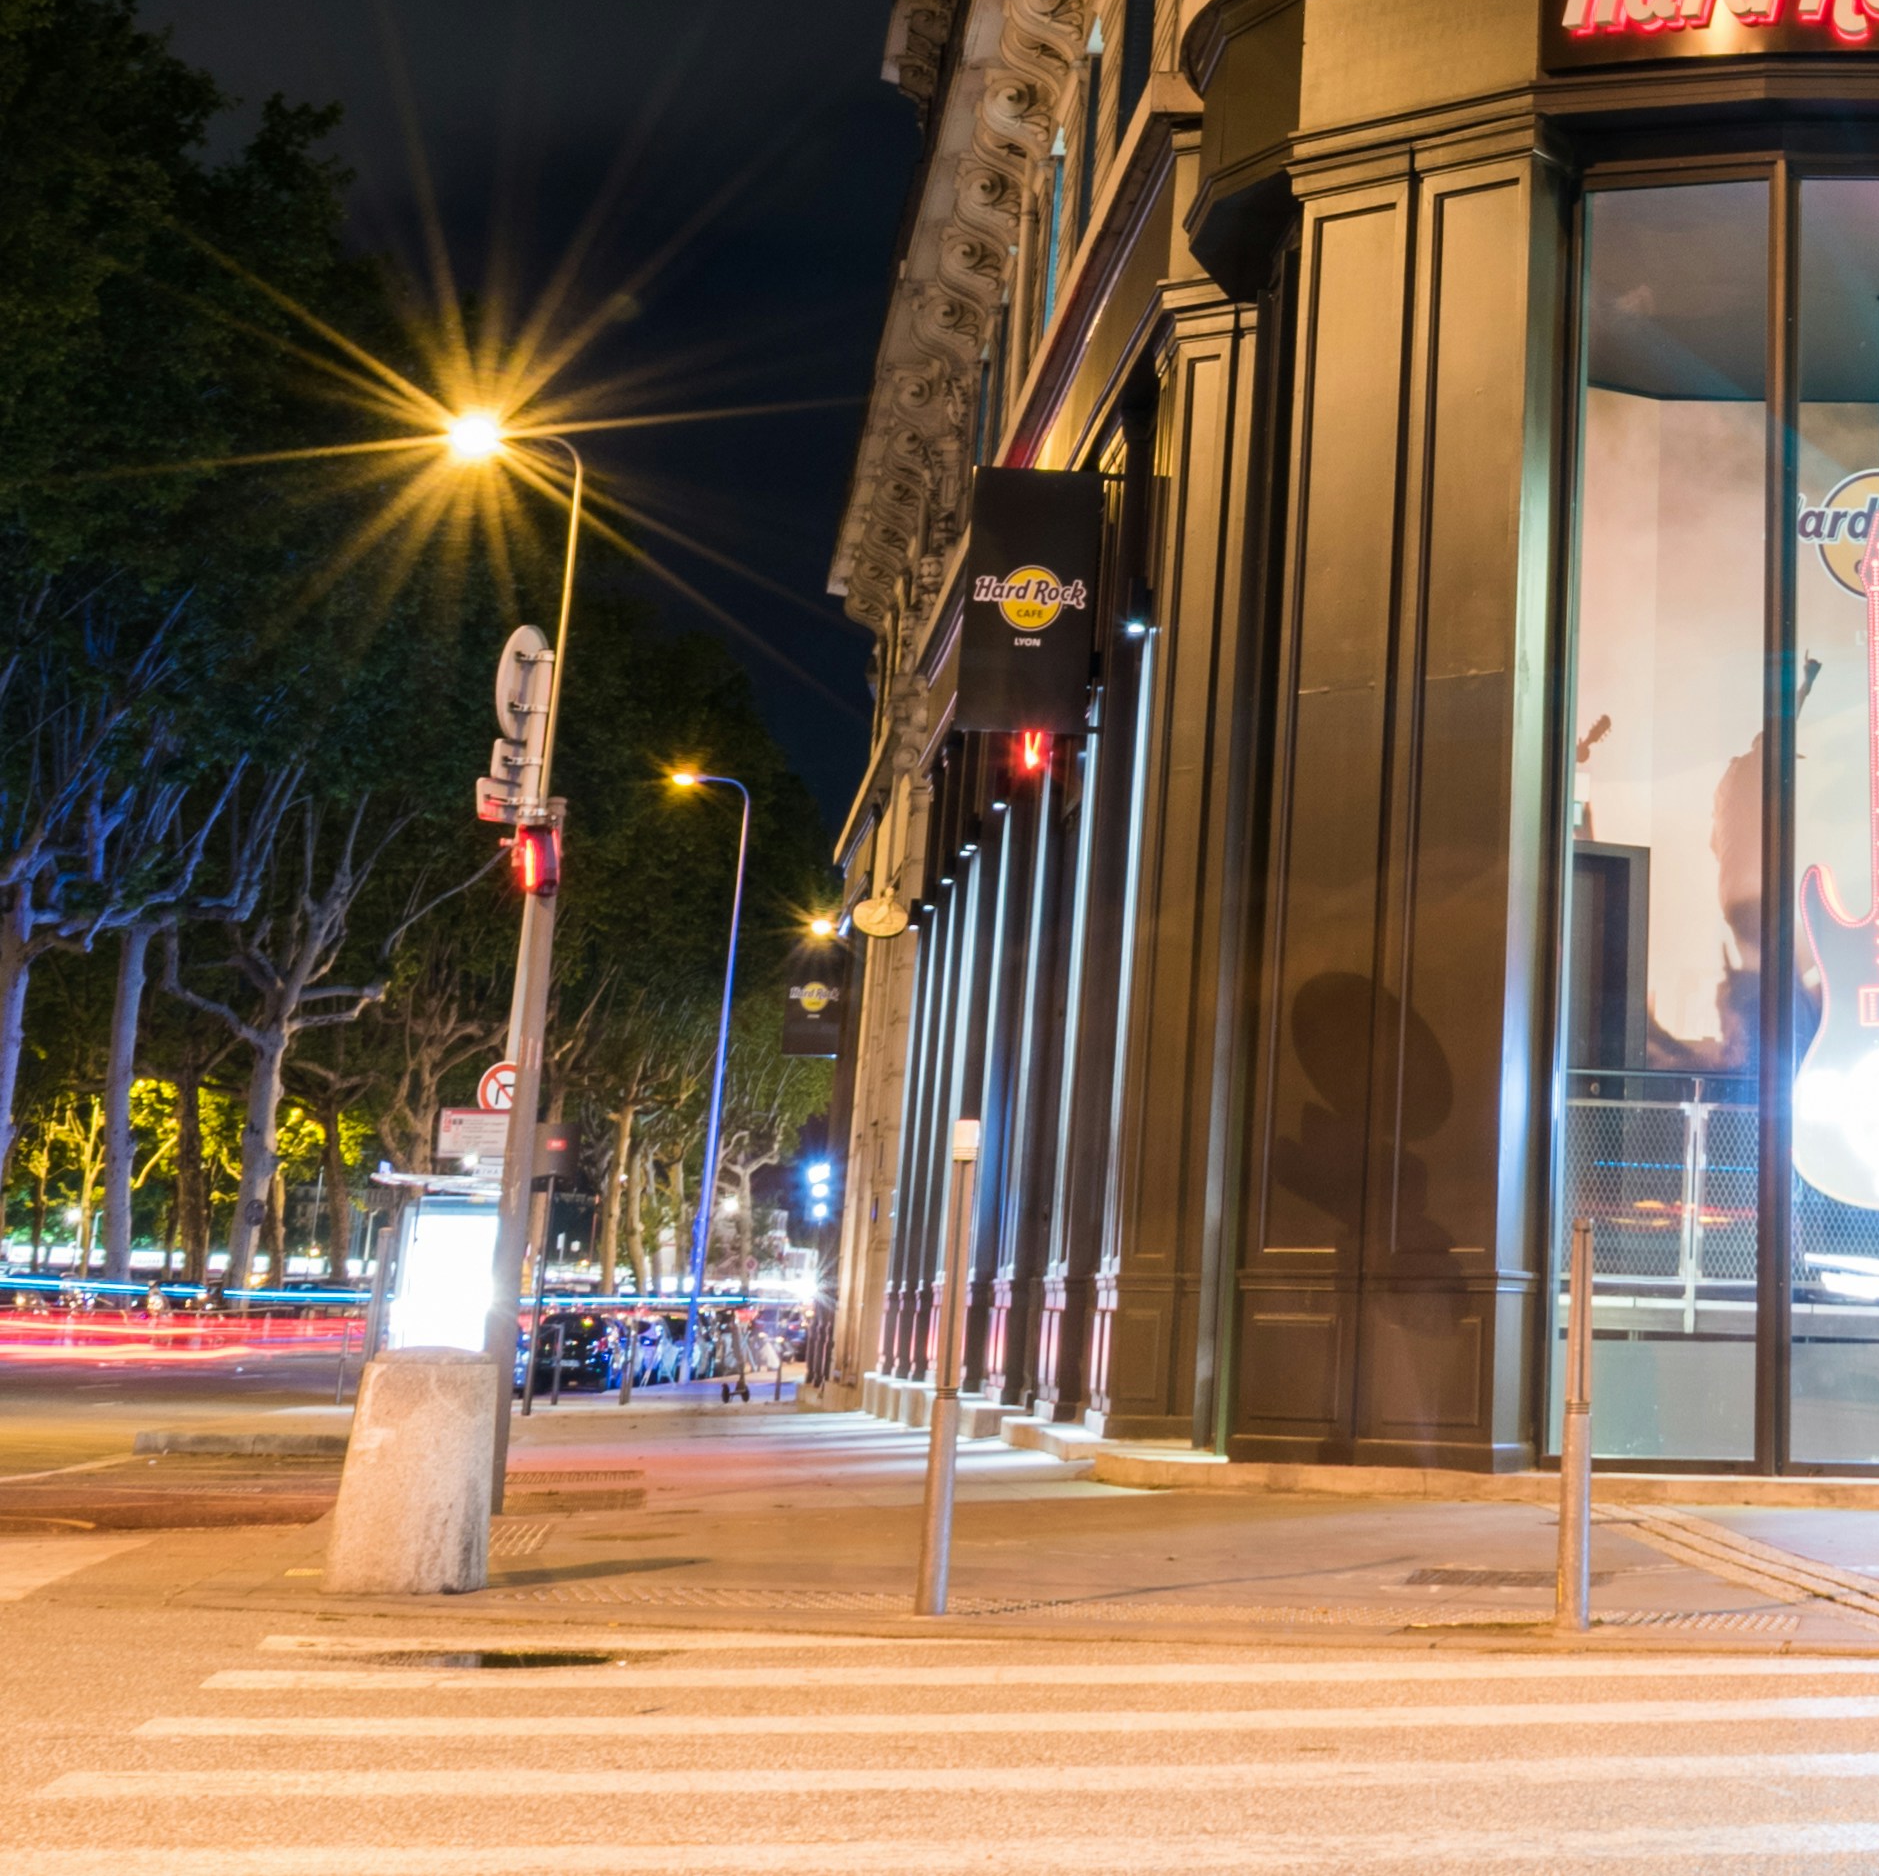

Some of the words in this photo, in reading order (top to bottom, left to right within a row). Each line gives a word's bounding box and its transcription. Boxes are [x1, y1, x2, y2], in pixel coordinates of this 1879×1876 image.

[1798, 493, 1879, 543] ard
[974, 576, 1032, 603] Hard
[1033, 580, 1087, 609] Rock
[1016, 608, 1044, 618] CAFE
[1014, 637, 1042, 647] LYON
